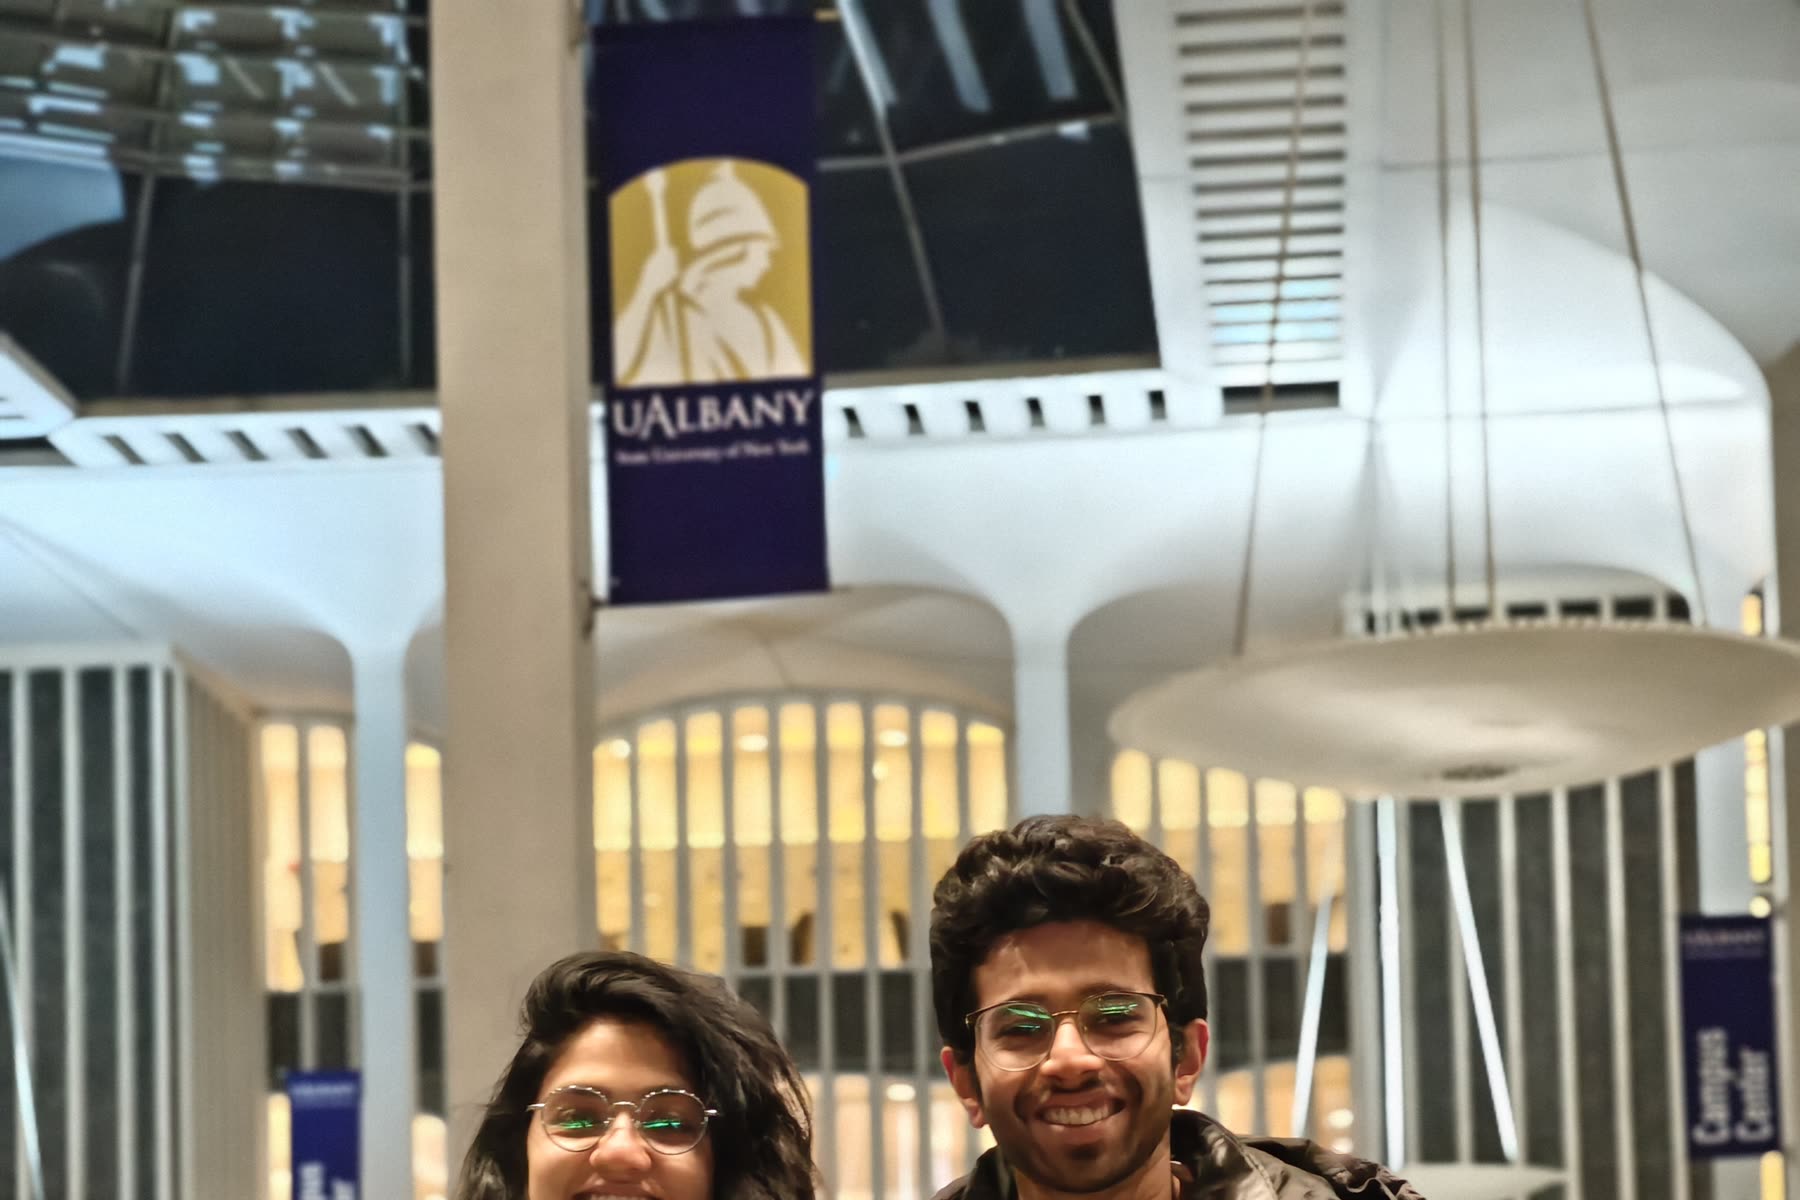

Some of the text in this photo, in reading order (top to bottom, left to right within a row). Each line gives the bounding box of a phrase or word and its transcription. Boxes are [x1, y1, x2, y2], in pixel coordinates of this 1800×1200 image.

[613, 389, 814, 440] UALBANY
[1693, 1028, 1737, 1144] Campus
[1736, 1047, 1773, 1141] Center
